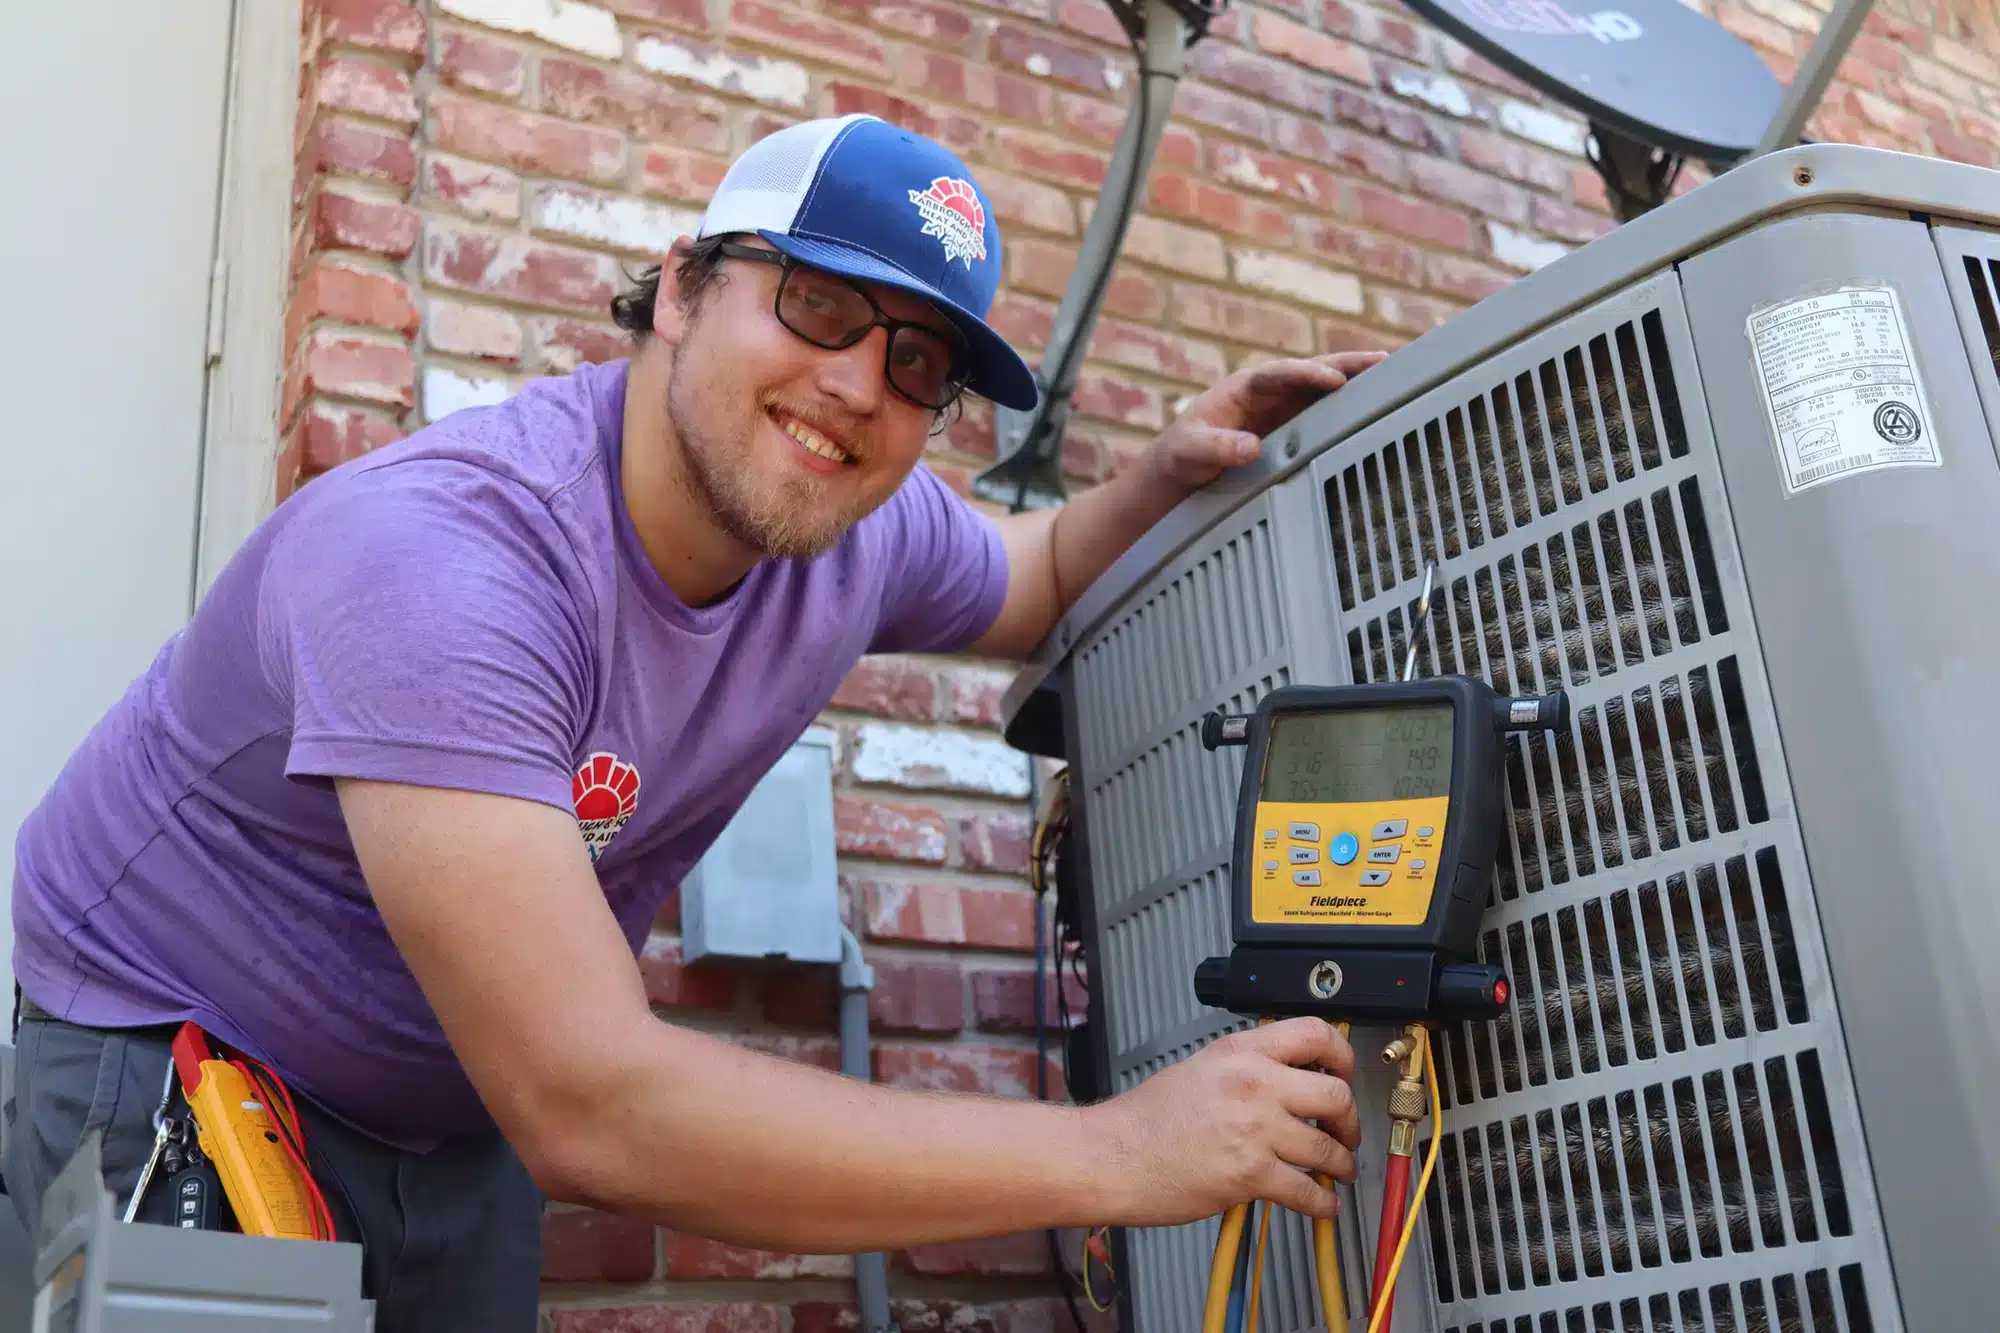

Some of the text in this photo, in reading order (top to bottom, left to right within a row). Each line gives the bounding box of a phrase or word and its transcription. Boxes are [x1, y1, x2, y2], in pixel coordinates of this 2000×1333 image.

[912, 192, 971, 230] YARBROUGH
[922, 207, 968, 239] HEAT AND
[1756, 300, 1819, 329] Allegiance 18
[1772, 384, 1800, 397] AMERICAN
[1802, 374, 1833, 385] STANDARD
[1802, 452, 1823, 464] ENERGY
[1309, 896, 1366, 907] Fieldpiece
